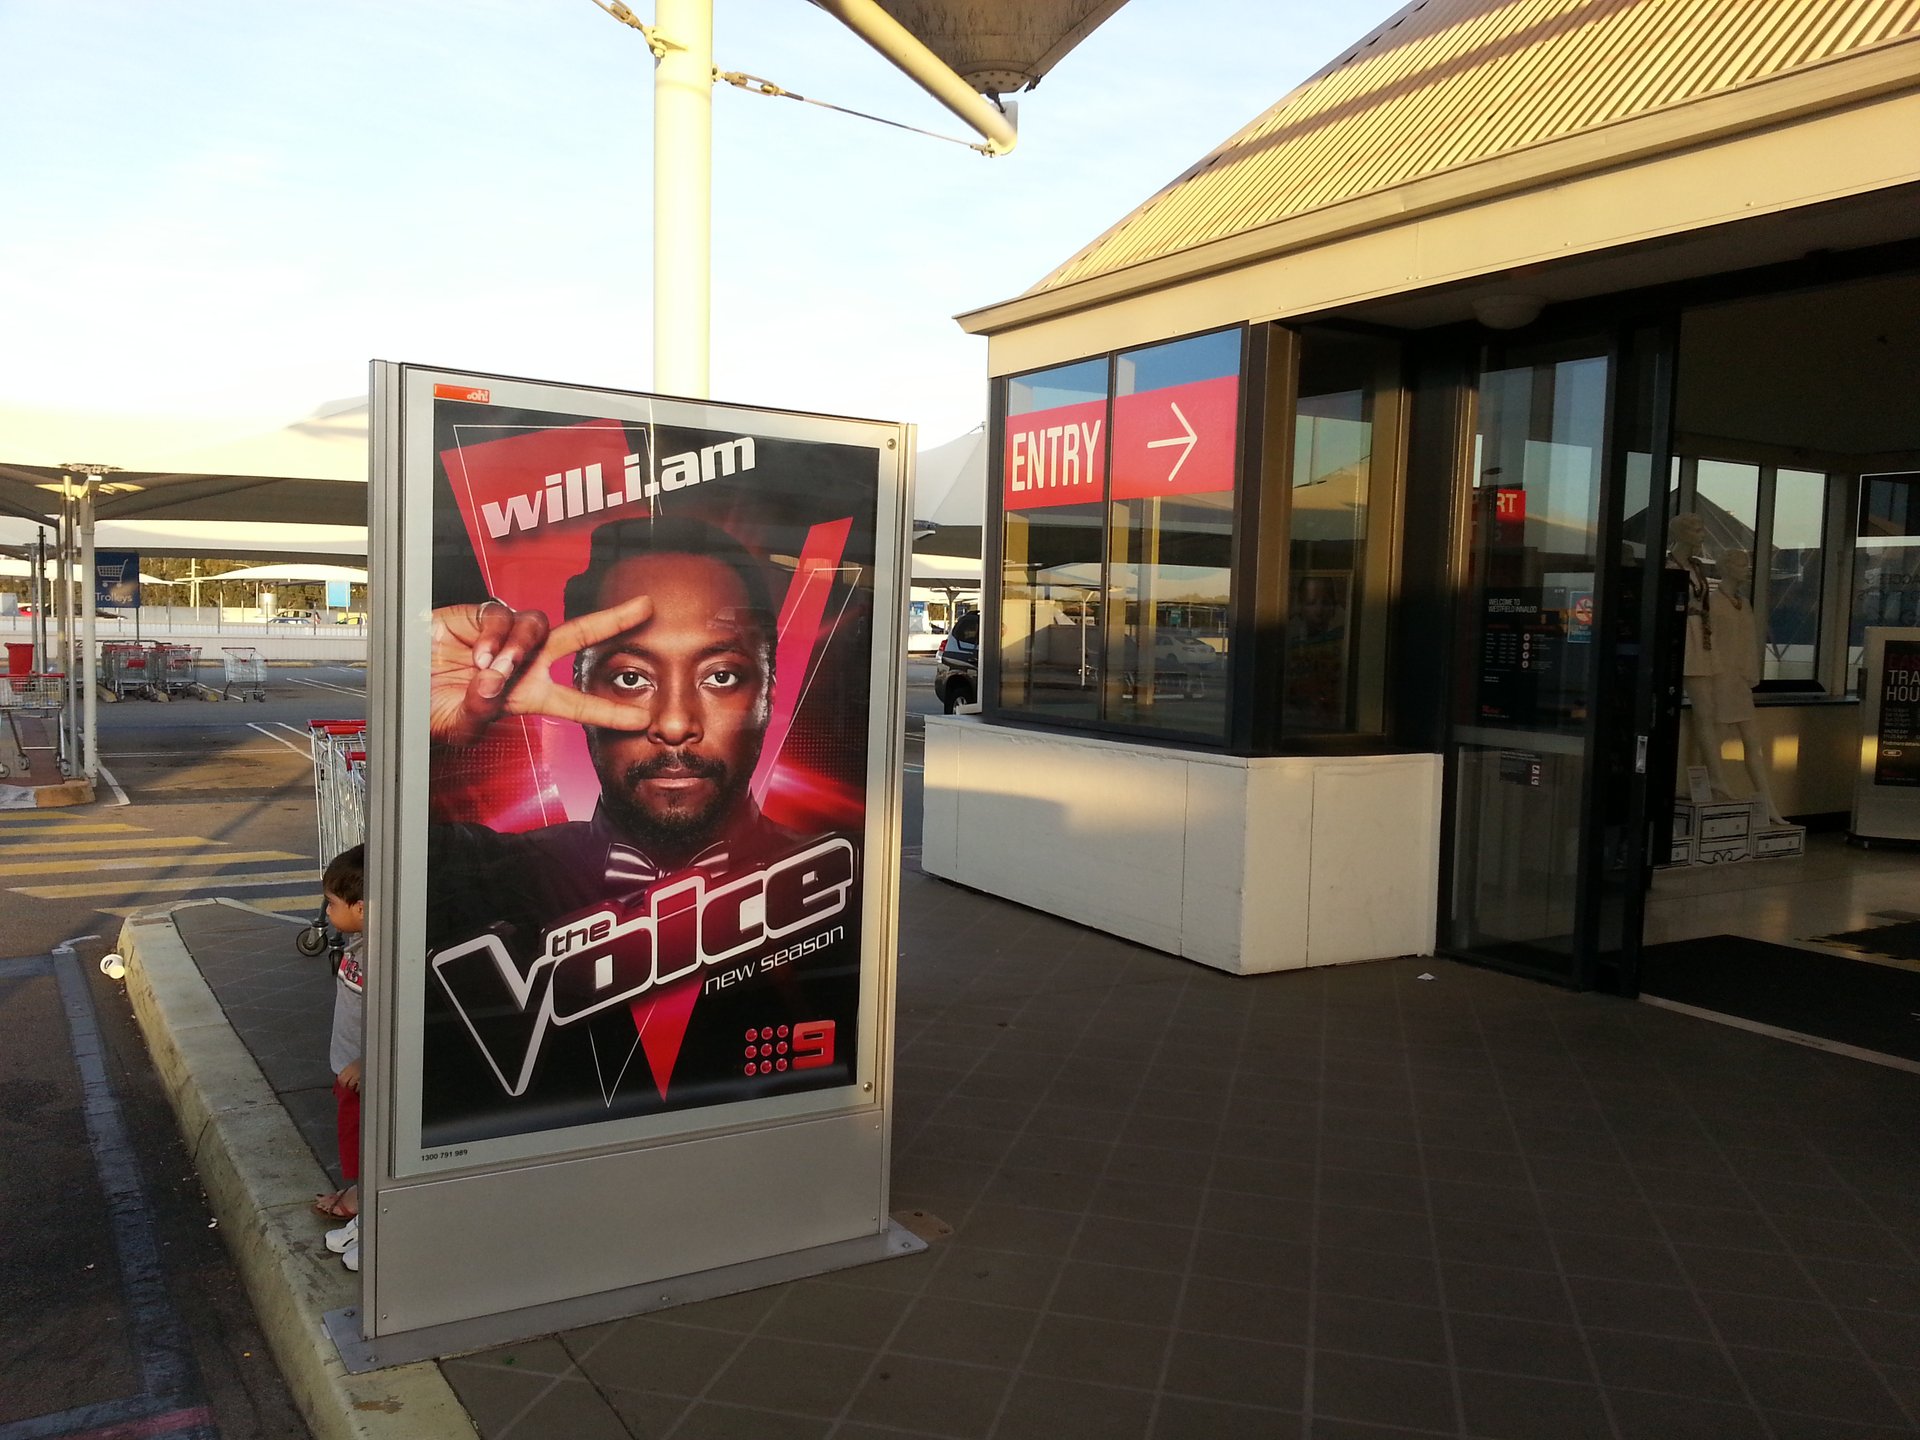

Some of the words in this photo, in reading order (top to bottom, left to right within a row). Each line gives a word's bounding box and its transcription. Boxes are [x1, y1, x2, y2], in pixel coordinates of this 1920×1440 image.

[1011, 419, 1102, 492] ENTRY
[480, 436, 756, 540] will.i.am
[94, 592, 133, 604] Trolleys
[1488, 598, 1513, 606] WELCOME
[1513, 598, 1521, 606] TO
[1488, 605, 1515, 613] WESTFIELD
[551, 918, 612, 957] the
[705, 959, 757, 995] new
[760, 925, 845, 973] season
[791, 1019, 836, 1069] 9
[421, 1153, 439, 1162] 1300
[440, 1151, 453, 1159] 791
